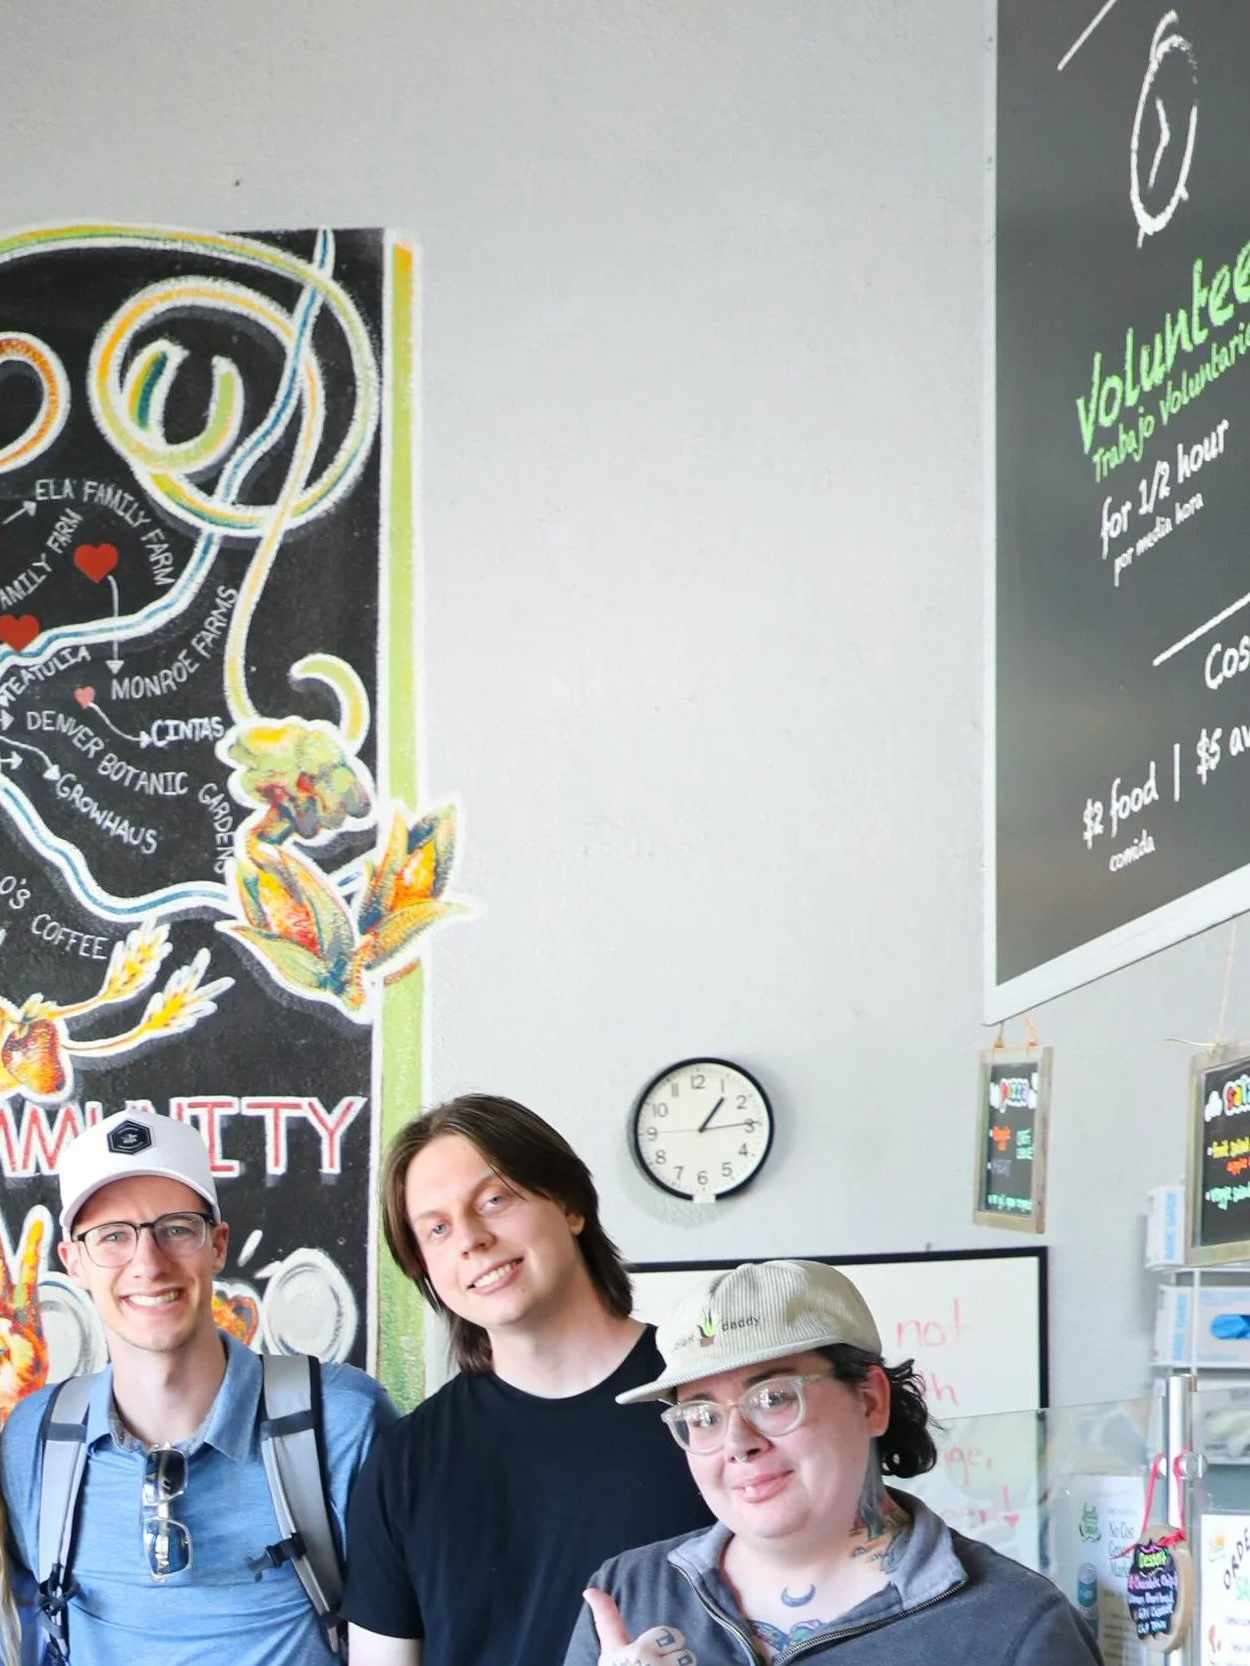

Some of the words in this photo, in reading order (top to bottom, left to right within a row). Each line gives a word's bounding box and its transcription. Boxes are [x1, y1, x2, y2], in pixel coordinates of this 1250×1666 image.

[1092, 406, 1155, 483] Trabajo
[1101, 496, 1132, 559] for
[1139, 460, 1171, 515] 1/2
[1177, 419, 1230, 484] hour
[35, 478, 75, 501] ELA
[83, 480, 151, 528] FAMILY
[141, 528, 176, 587] FARM
[47, 508, 84, 554] FARM
[1114, 547, 1135, 587] por
[111, 648, 200, 700] MONROE
[191, 585, 239, 658] FARMS
[152, 716, 225, 747] CINTAS
[27, 711, 104, 758] DENVER
[98, 753, 189, 796] BOTANIC
[198, 783, 236, 874] GARDENS
[1083, 798, 1104, 849] $2
[1110, 760, 1159, 838] food
[1196, 728, 1222, 785] $5
[56, 773, 158, 855] GROWHAUS
[1109, 829, 1156, 872] comida
[31, 912, 111, 961] COFFEE
[670, 1082, 679, 1098] 11
[690, 1074, 706, 1090] 12
[719, 1078, 726, 1094] 1
[652, 1103, 668, 1118] 10
[736, 1094, 747, 1110] 2
[646, 1127, 658, 1141] 9
[744, 1118, 756, 1133] 3
[655, 1150, 667, 1165] 8
[738, 1143, 749, 1158] 4
[673, 1166, 684, 1181] 7
[697, 1171, 709, 1185] 6
[721, 1162, 733, 1177] 5
[721, 1313, 760, 1332] daddy
[896, 1298, 976, 1348] not
